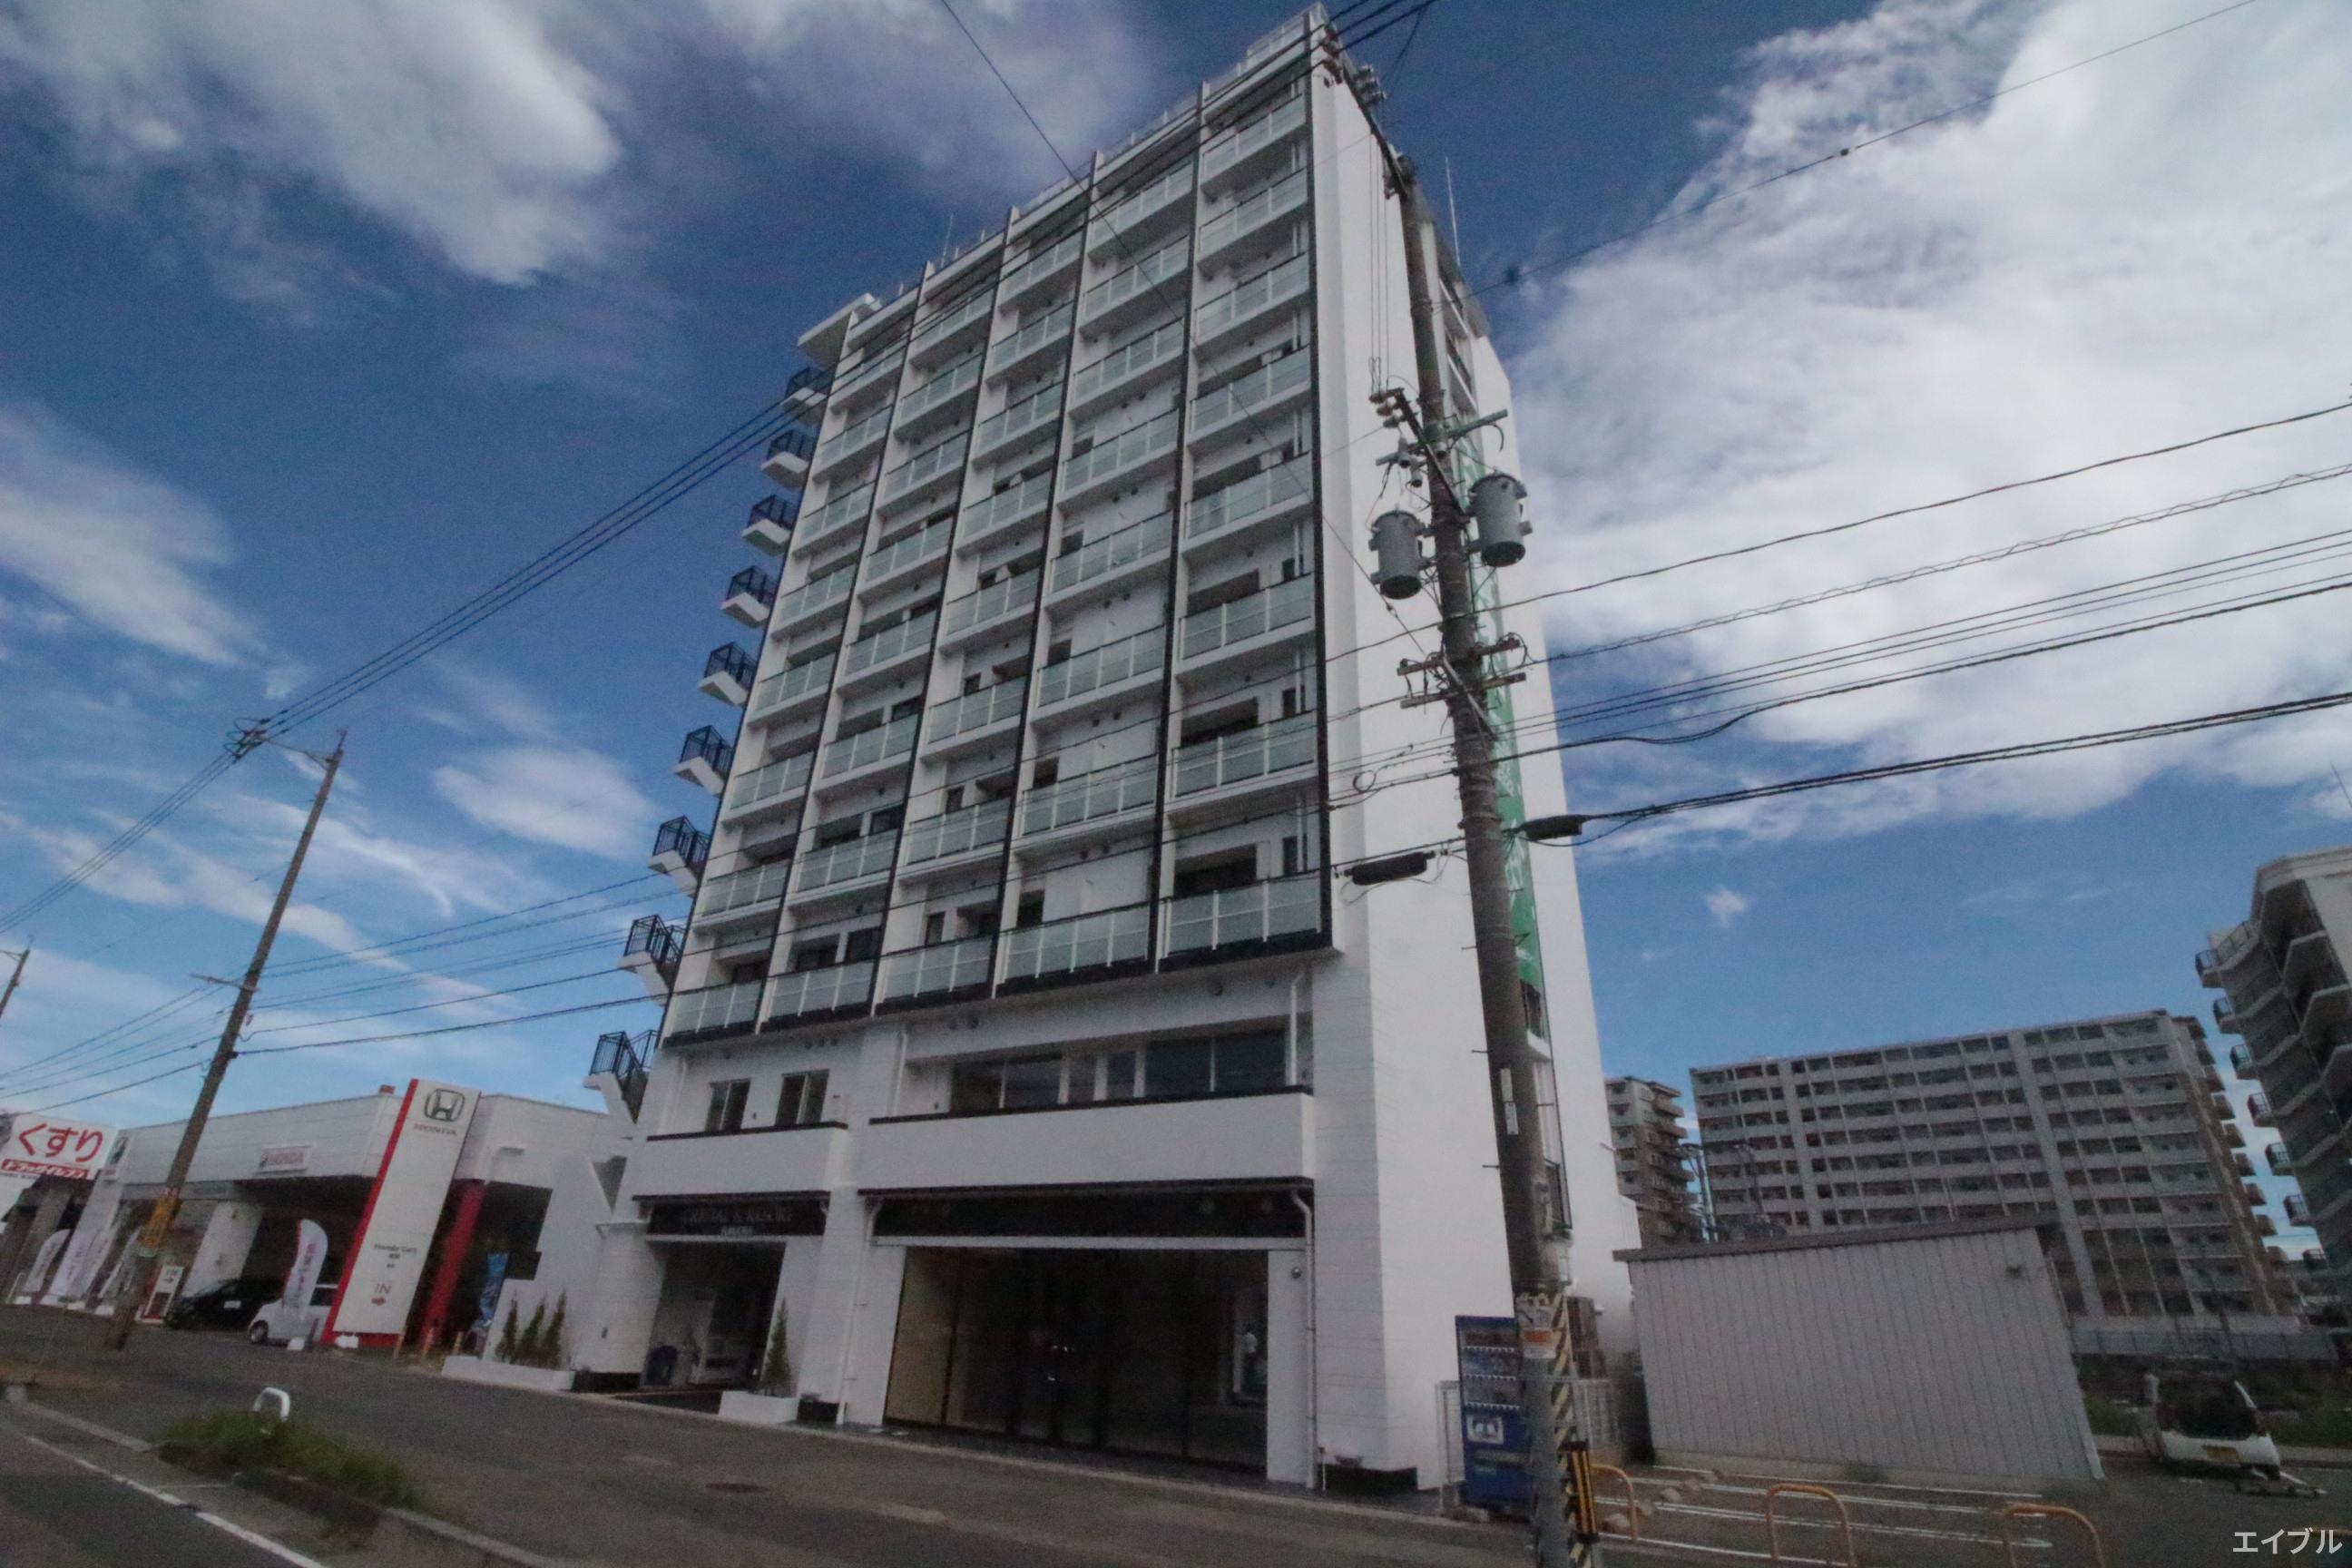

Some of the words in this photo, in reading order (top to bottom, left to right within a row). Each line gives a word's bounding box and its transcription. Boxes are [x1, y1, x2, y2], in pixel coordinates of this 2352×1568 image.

[18, 1122, 103, 1162] くすり
[374, 1282, 393, 1295] IN
